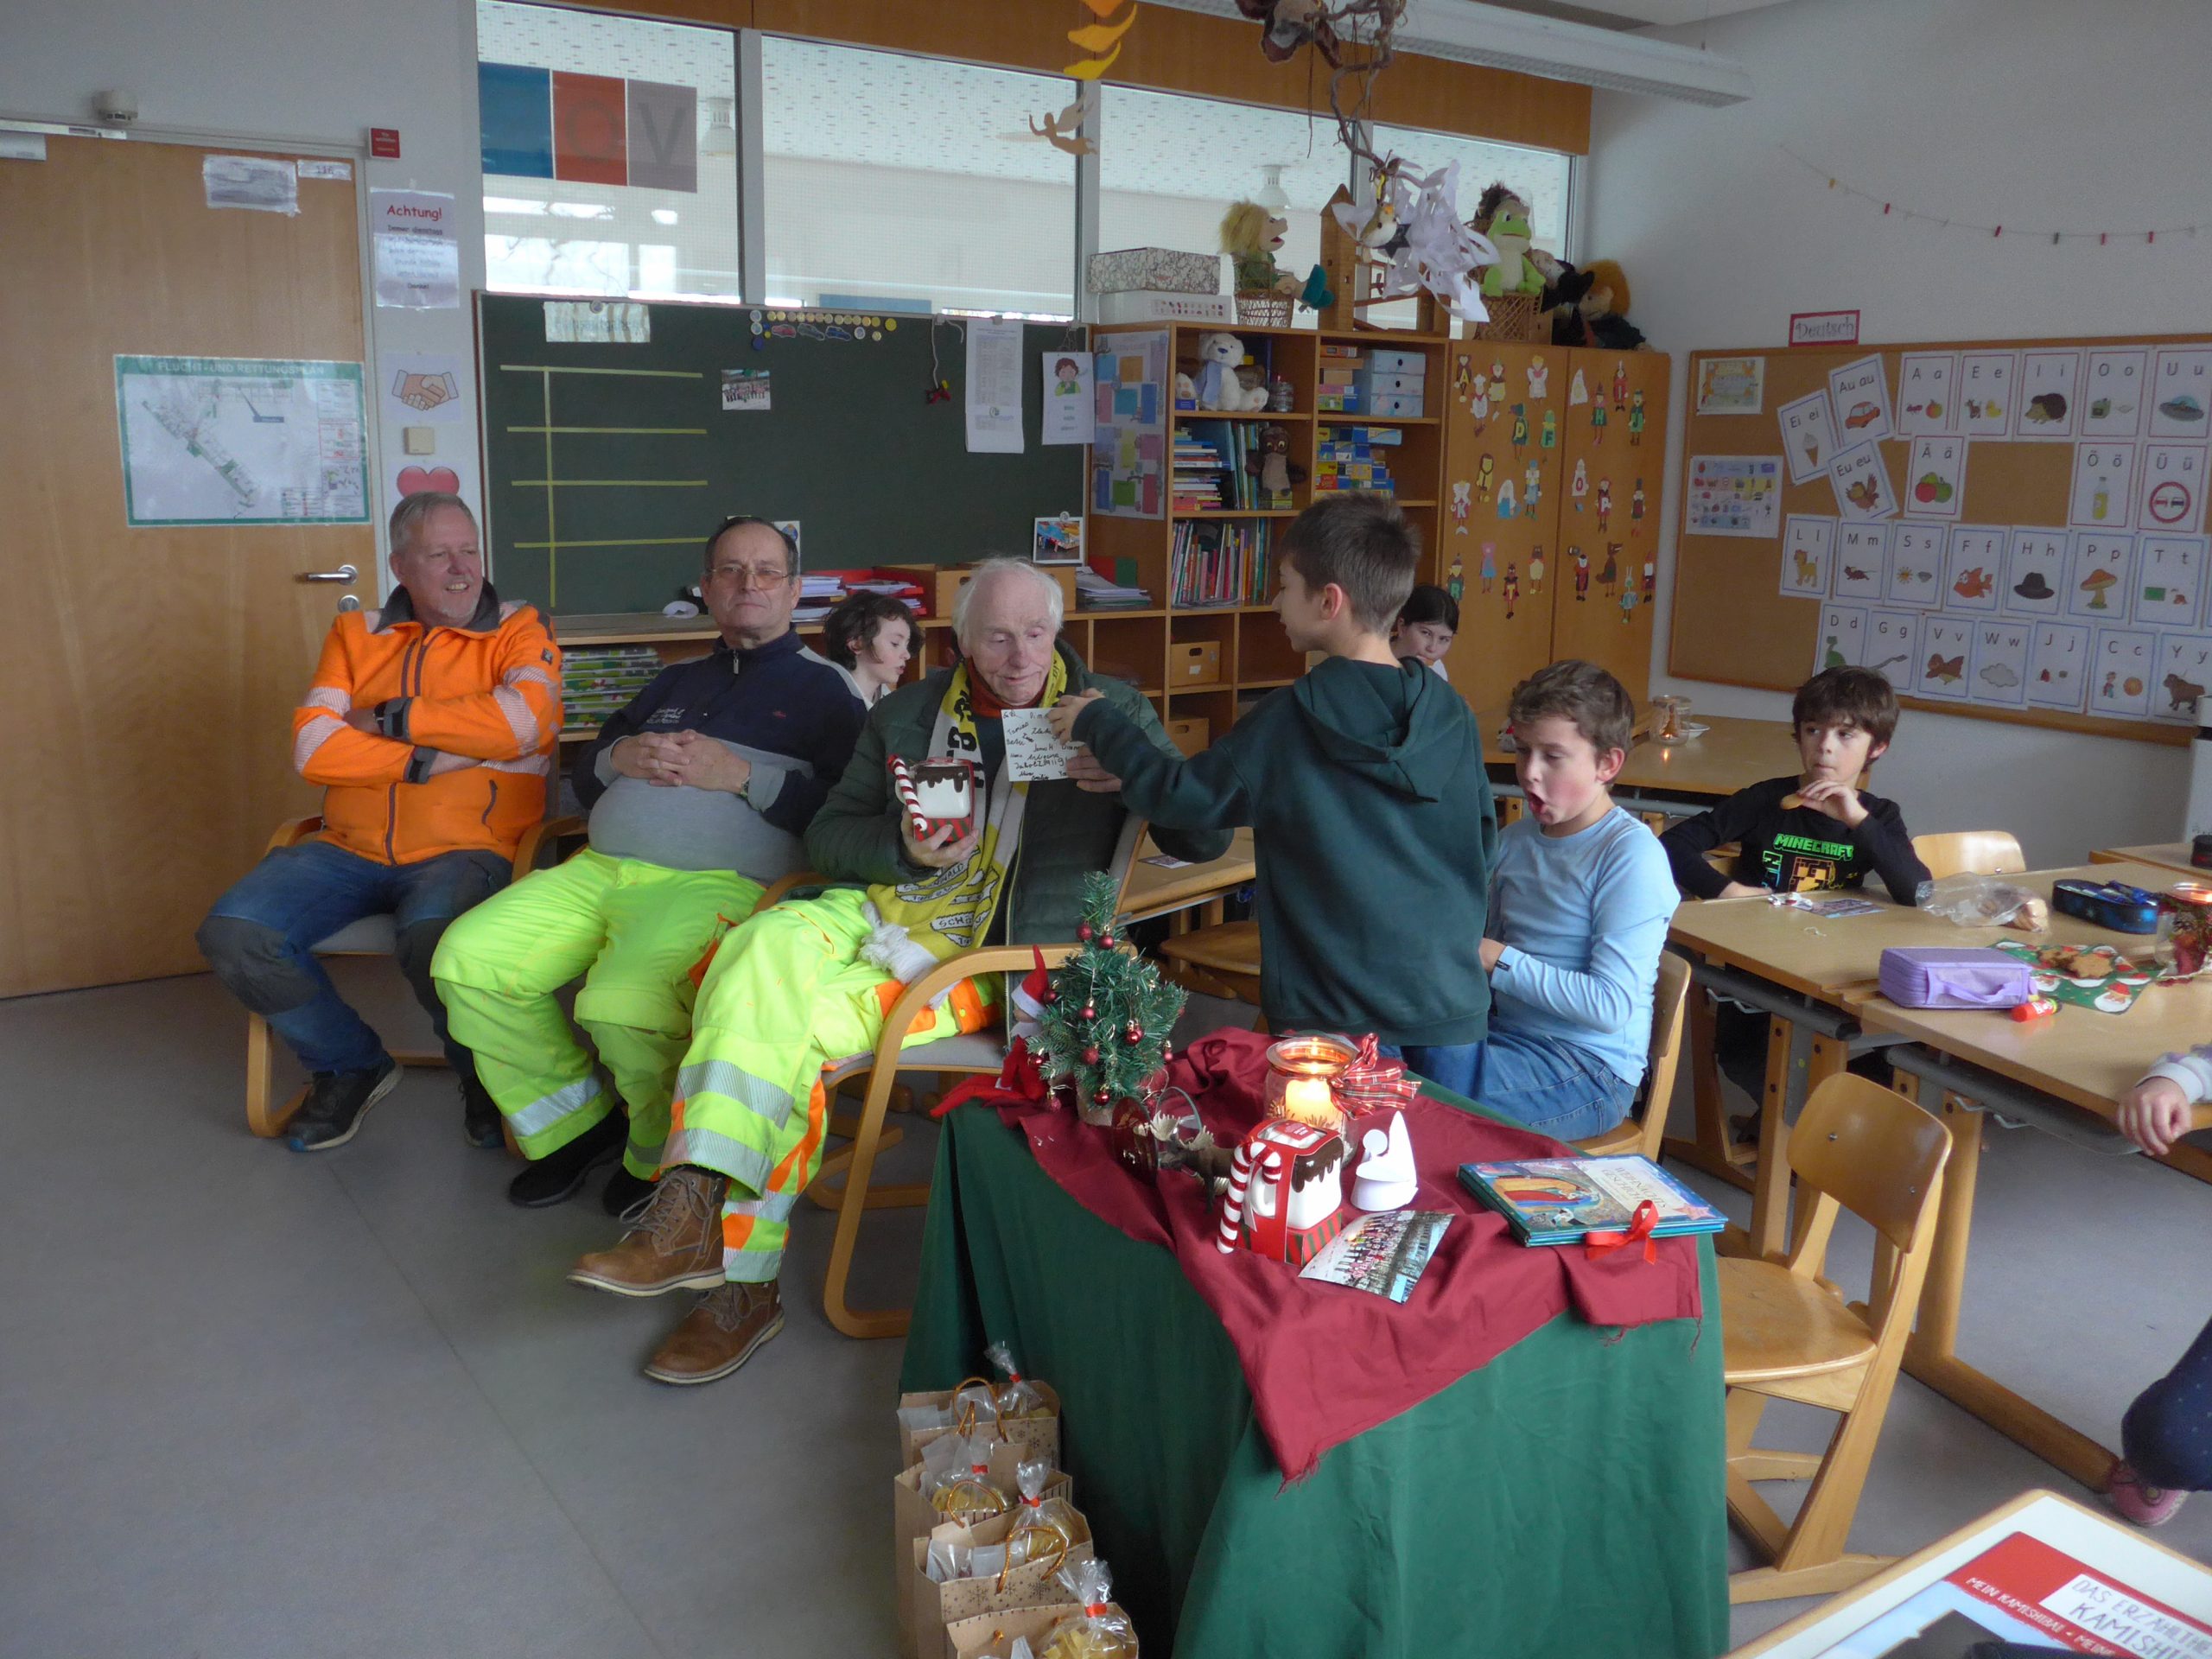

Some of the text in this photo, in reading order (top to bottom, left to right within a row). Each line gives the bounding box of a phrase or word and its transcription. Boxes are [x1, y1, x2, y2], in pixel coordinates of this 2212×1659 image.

[387, 204, 442, 221] Achtung!
[1796, 316, 1854, 340] Deutsch
[237, 364, 325, 375] RETTUNGSPLAN
[1912, 367, 1942, 380] A a
[1972, 365, 2002, 378] E e
[2098, 362, 2134, 377] O o
[2167, 362, 2203, 377] U u
[1840, 374, 1875, 394] Au au
[1790, 408, 1819, 429] Ei ei
[1922, 442, 1953, 459] Ä ä
[2087, 449, 2122, 467] Ö ö
[1836, 454, 1871, 477] Eu eu
[2156, 452, 2193, 471] Ü ü
[1796, 528, 1803, 541] L
[1847, 533, 1878, 546] M m
[1904, 535, 1932, 549] S s
[1962, 540, 1992, 554] F f
[2022, 542, 2055, 556] H h
[2087, 543, 2120, 563] P p
[2154, 549, 2189, 564] T t
[1830, 614, 1858, 629] D d
[1878, 621, 1908, 639] G g
[1934, 627, 1963, 642] V v
[1986, 632, 2020, 647] W w
[2045, 633, 2075, 652] J j
[2107, 640, 2142, 657] C c
[2173, 645, 2209, 664] Y y
[1773, 833, 1854, 861] MINECRAFT
[2071, 1579, 2112, 1604] DAS
[1965, 1576, 2001, 1599] MEIN
[1997, 1592, 2066, 1634] KAMISHIBAI
